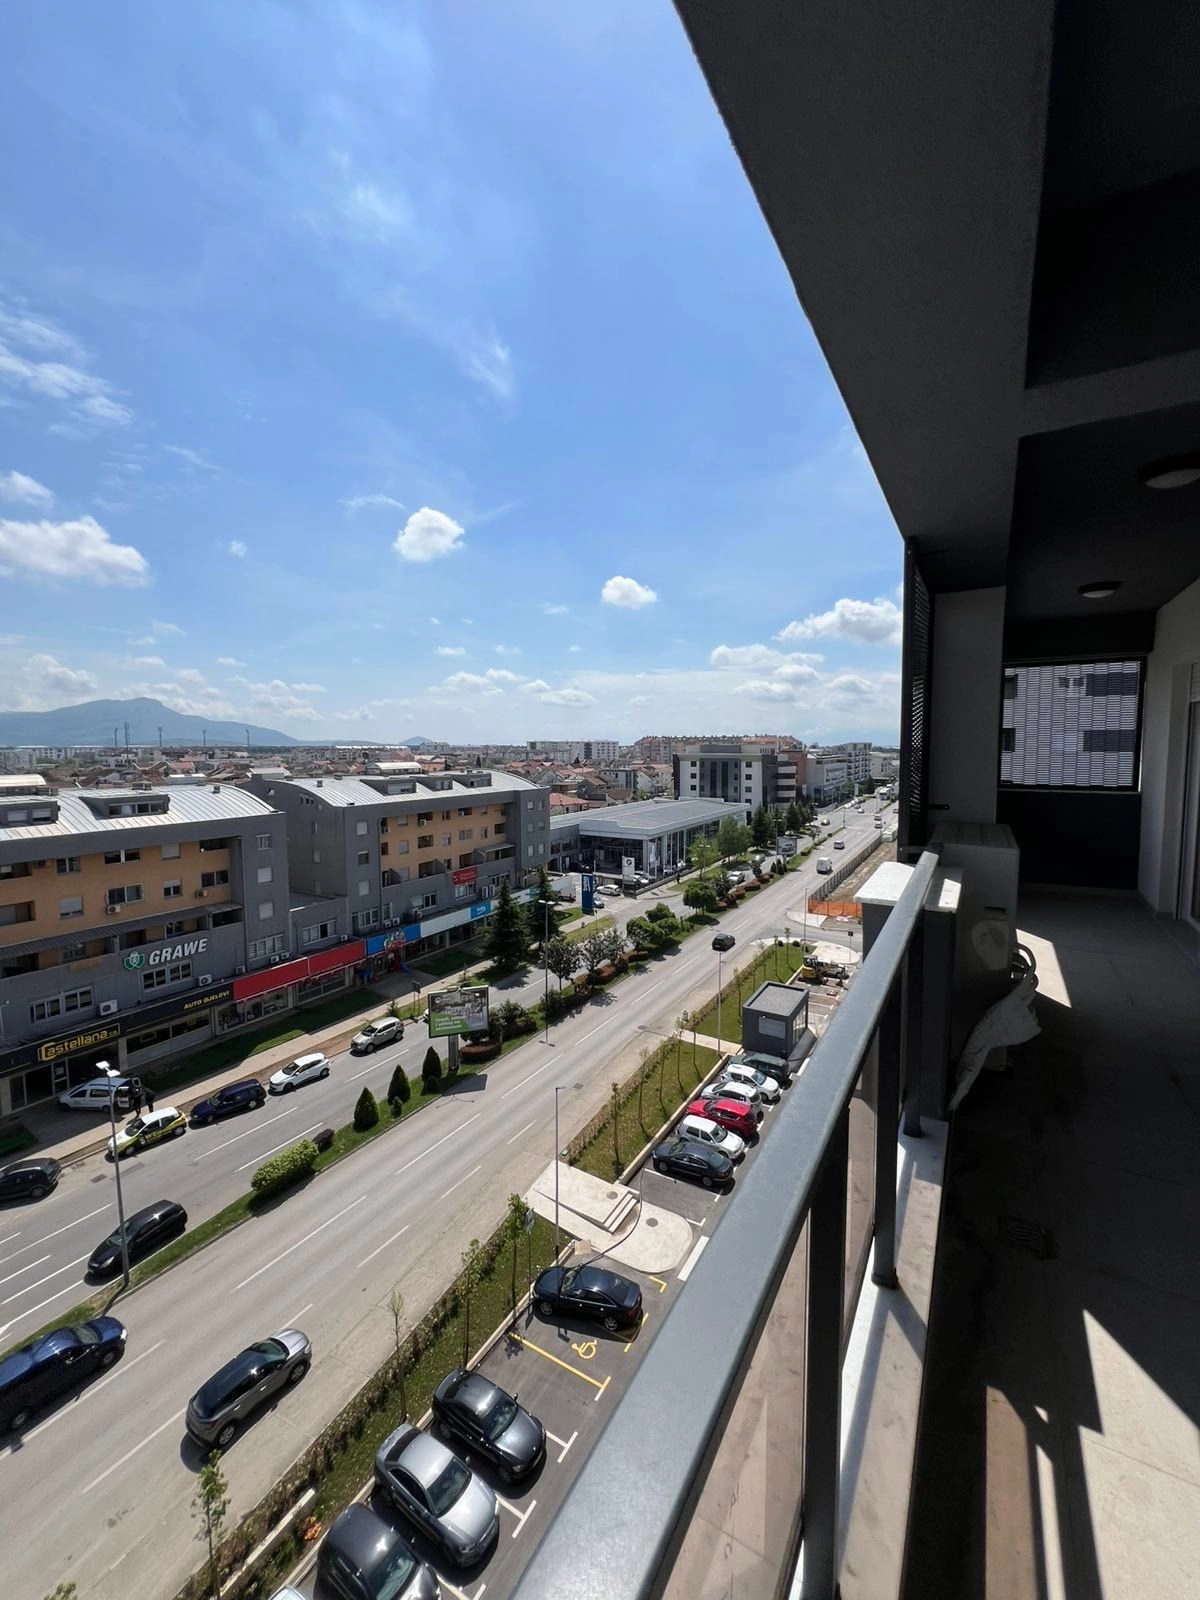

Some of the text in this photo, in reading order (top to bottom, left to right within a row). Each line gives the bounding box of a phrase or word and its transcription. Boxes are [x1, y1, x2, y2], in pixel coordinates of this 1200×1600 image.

[148, 938, 208, 965] GRAWE
[183, 999, 203, 1010] AUTO
[41, 1030, 108, 1061] Castellana
